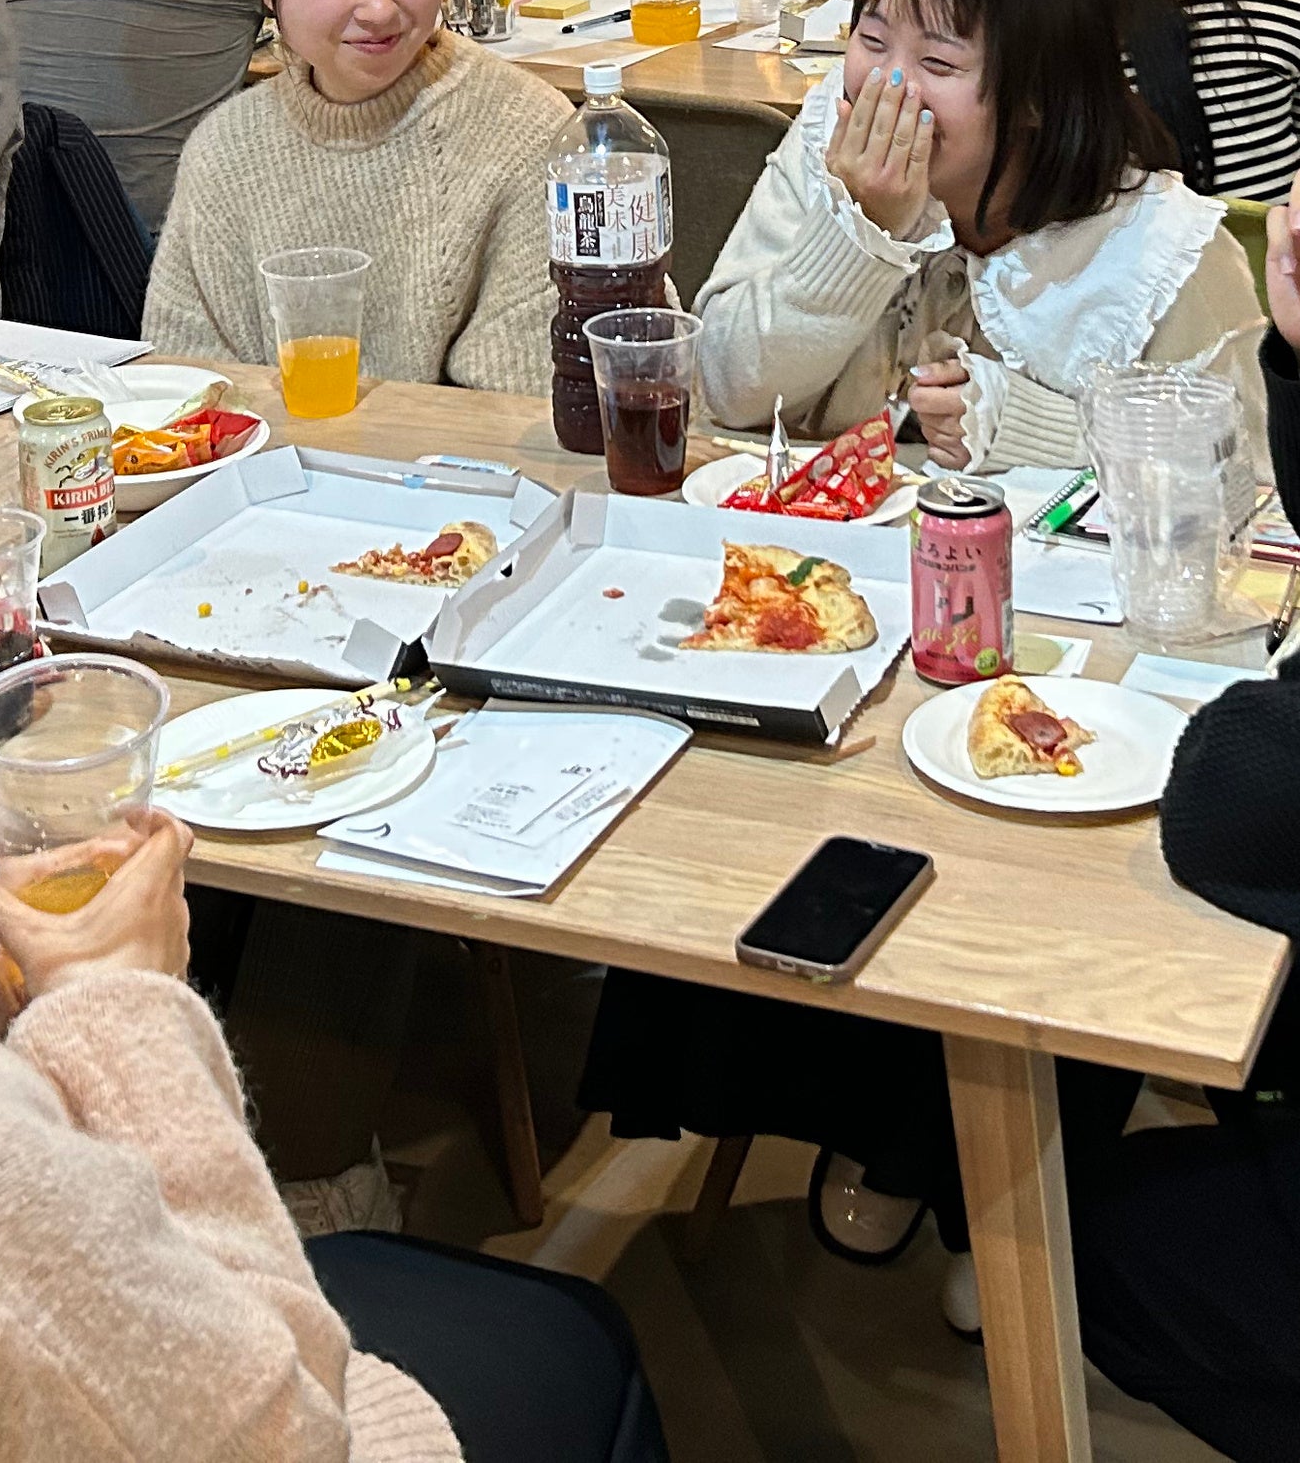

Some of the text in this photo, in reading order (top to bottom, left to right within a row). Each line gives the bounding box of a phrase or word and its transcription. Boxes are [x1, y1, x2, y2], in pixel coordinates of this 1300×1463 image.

[577, 196, 596, 248] 烏龍茶
[44, 438, 79, 469] KIRIN'S
[54, 486, 98, 505] KIRIN
